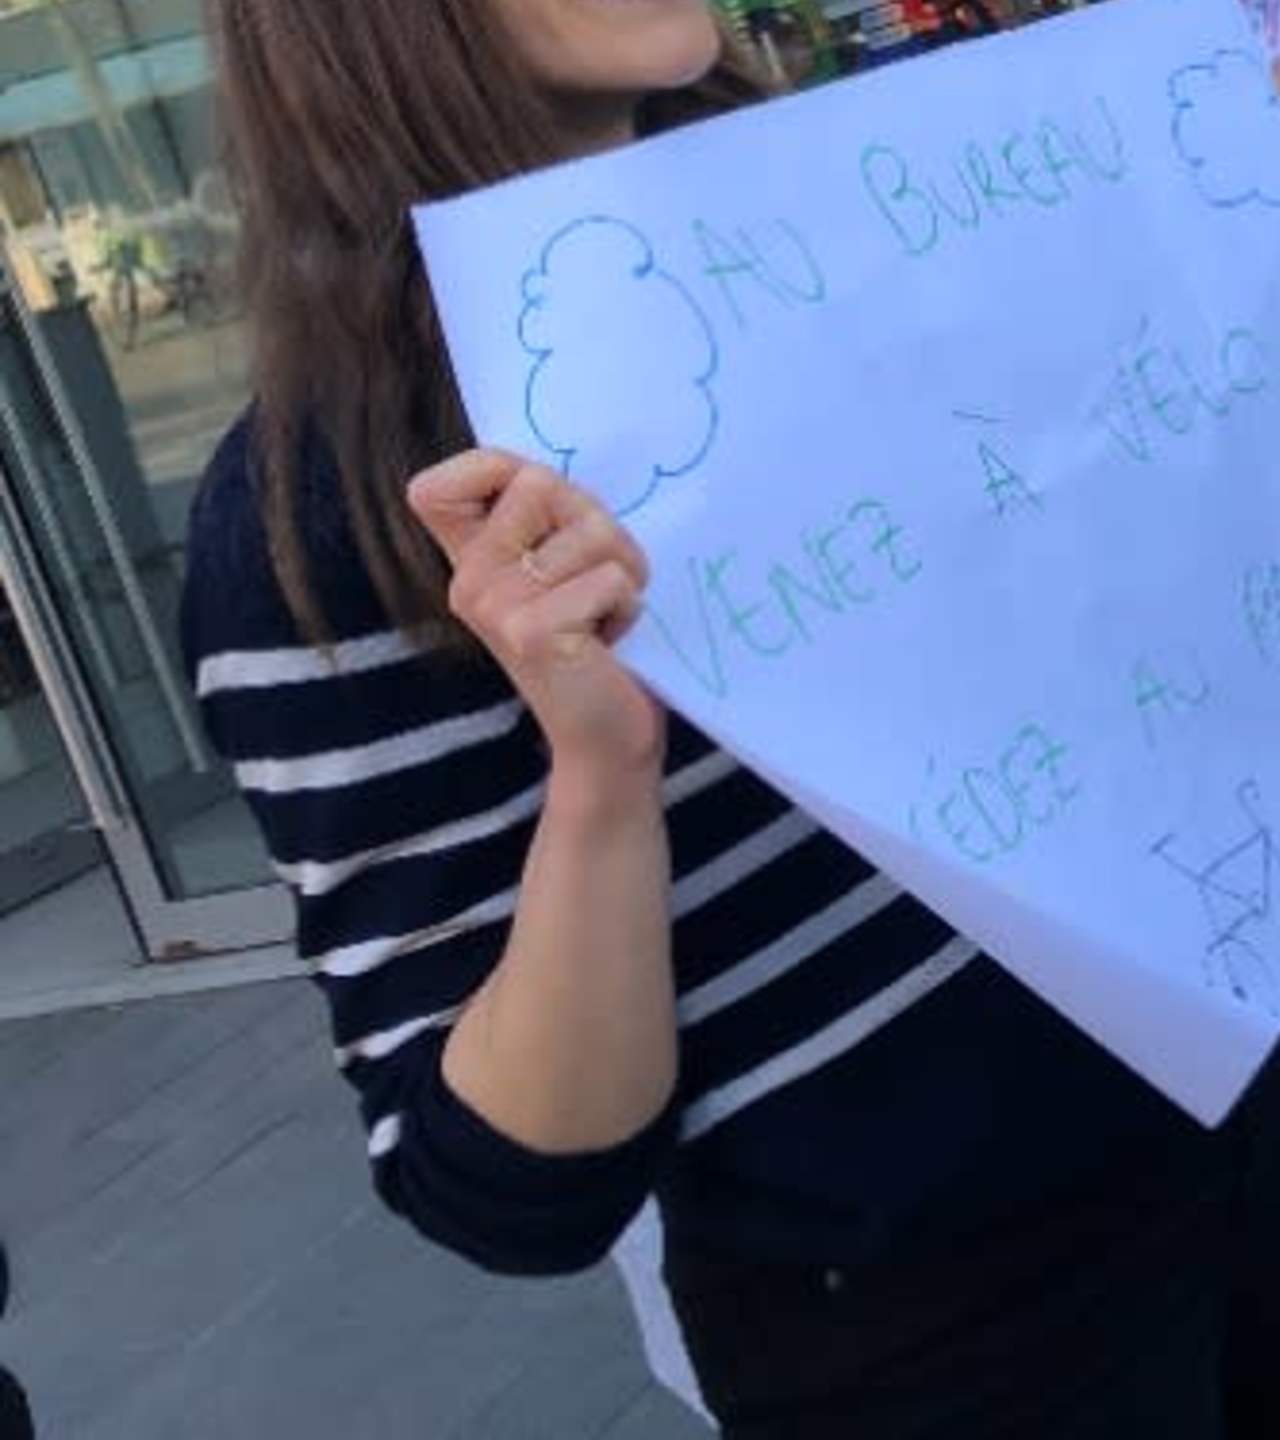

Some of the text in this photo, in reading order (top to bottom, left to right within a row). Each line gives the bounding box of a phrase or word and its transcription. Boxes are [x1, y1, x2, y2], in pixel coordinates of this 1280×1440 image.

[691, 96, 1124, 331] AU BUREAU
[648, 500, 924, 699] VENEZ
